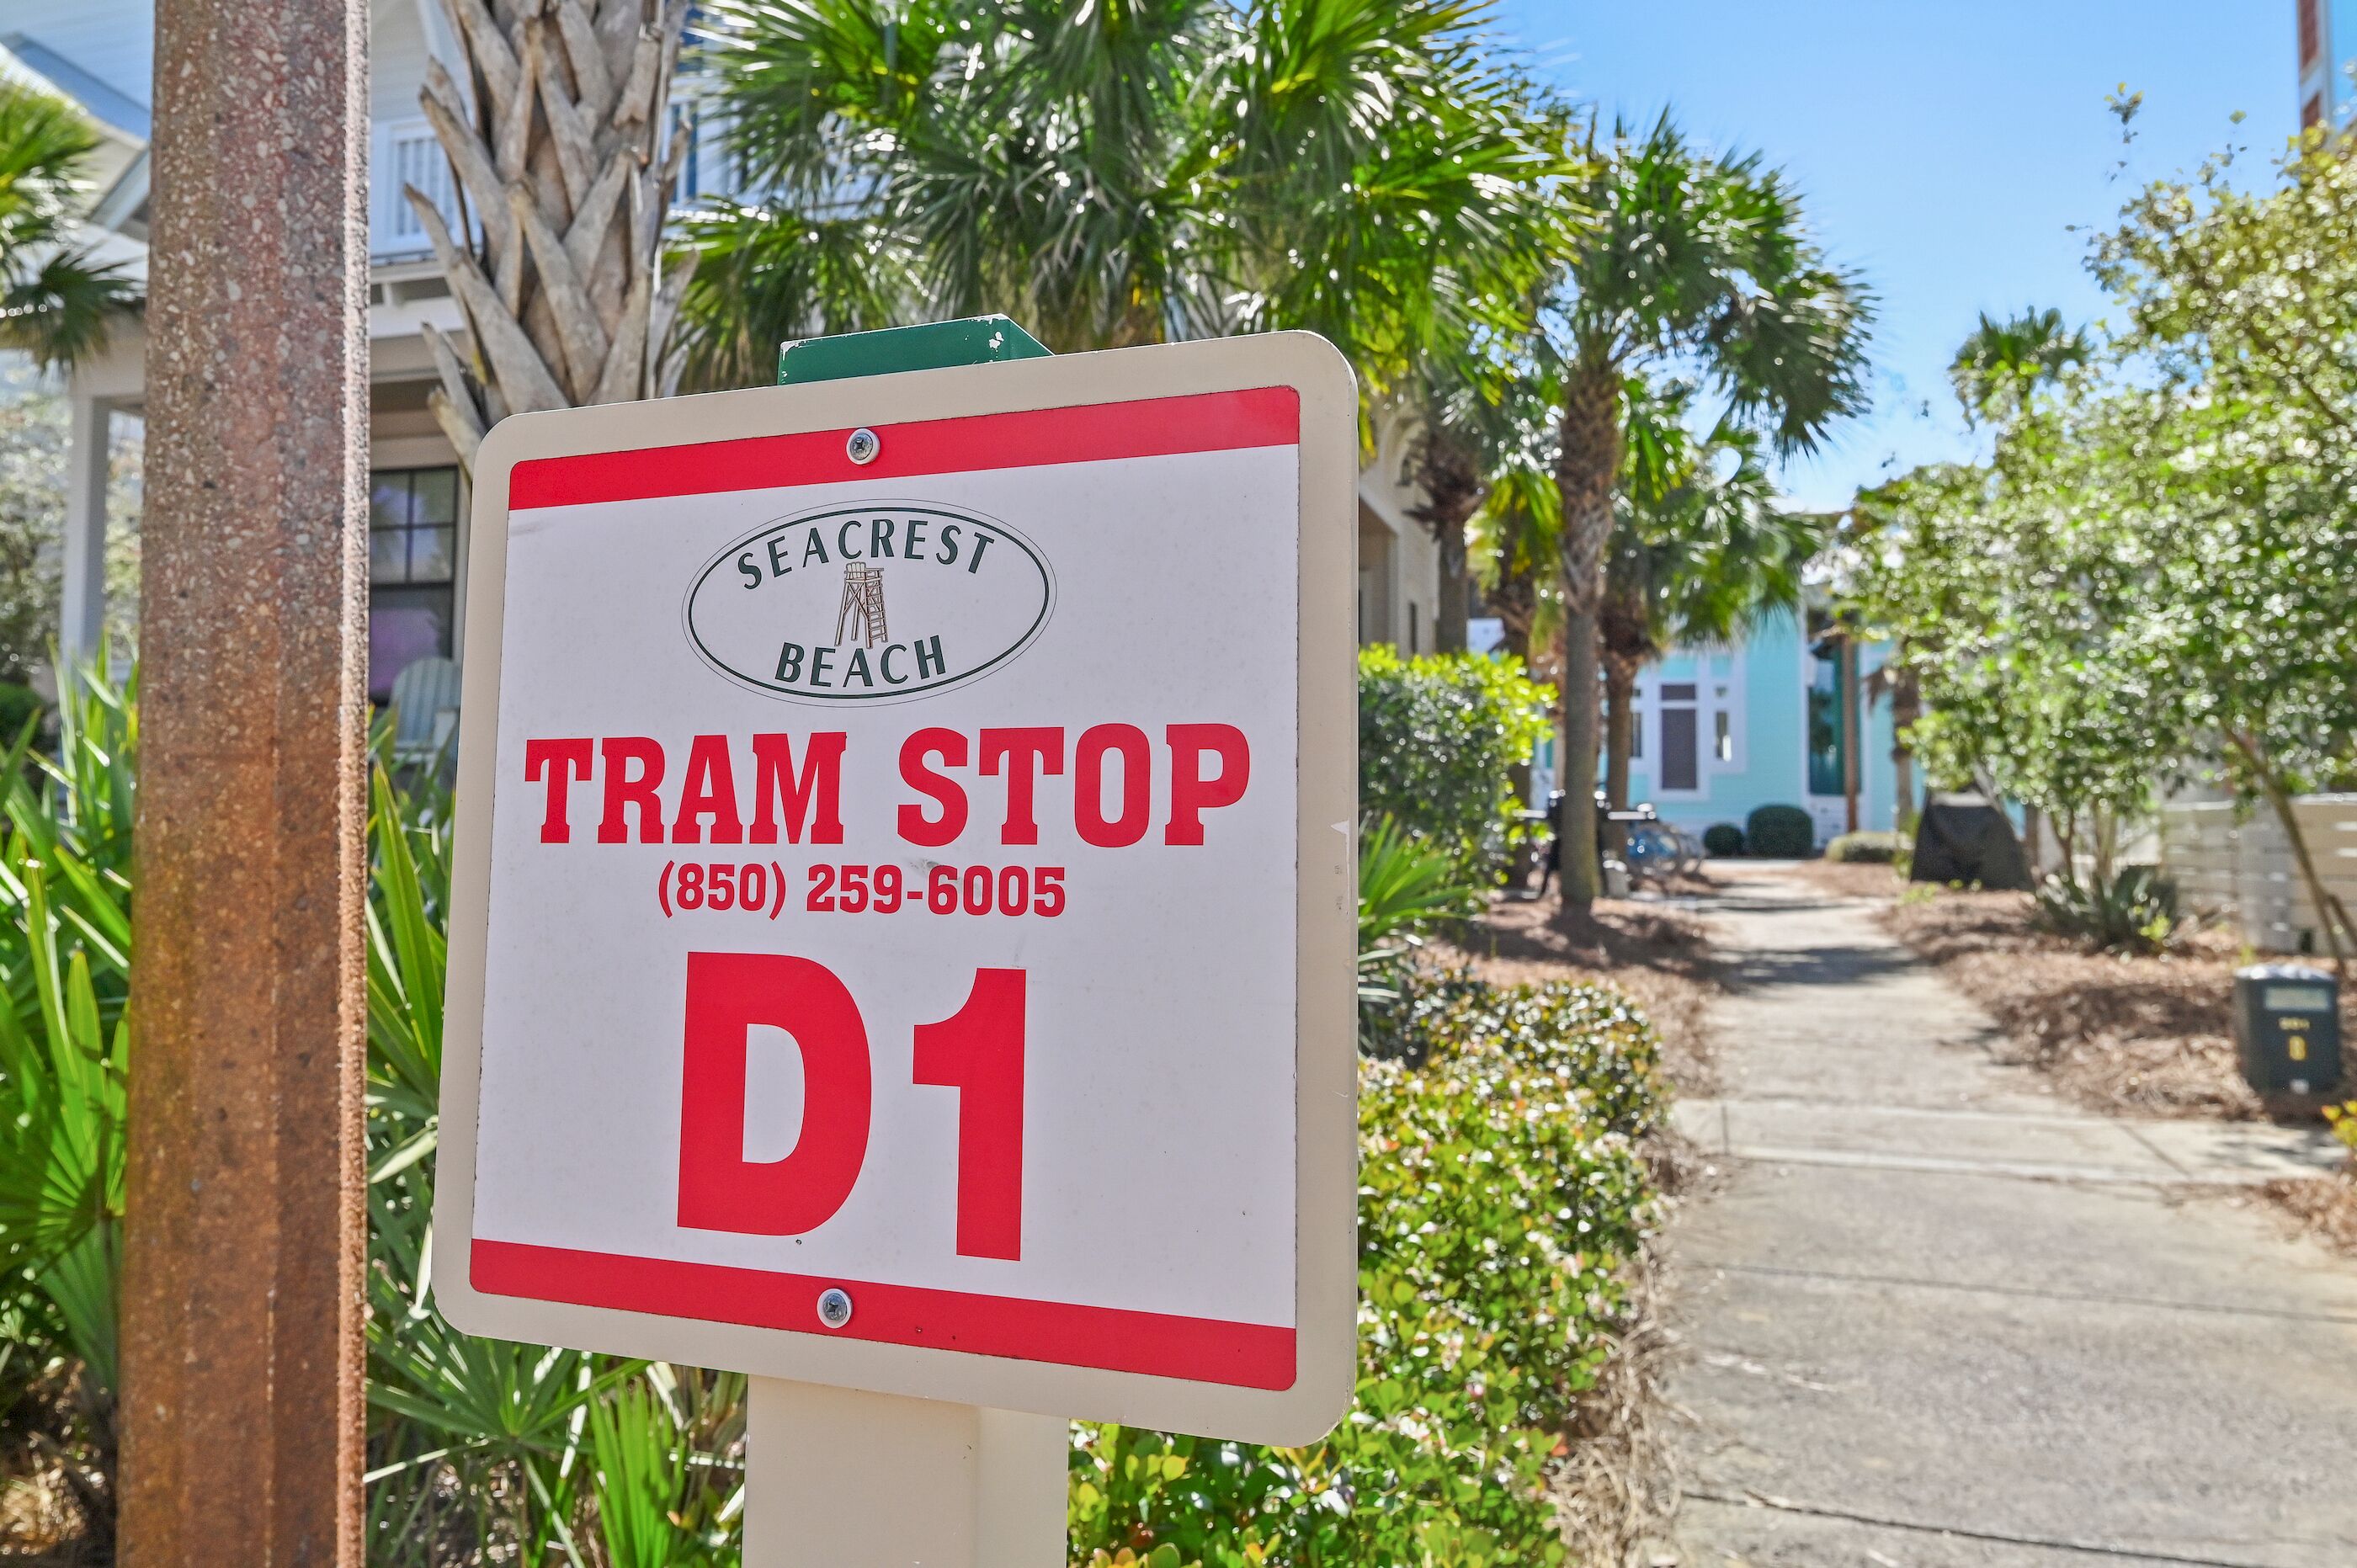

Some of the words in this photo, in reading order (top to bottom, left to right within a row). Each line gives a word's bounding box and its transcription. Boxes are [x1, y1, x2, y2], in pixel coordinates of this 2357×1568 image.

[737, 518, 995, 590] SEACREST
[774, 635, 946, 688] BEACH
[524, 731, 848, 845] TRAM
[897, 722, 1251, 848] STOP
[657, 860, 787, 922] (850)
[806, 863, 1067, 918] 259-6005
[677, 951, 1027, 1262] D1
